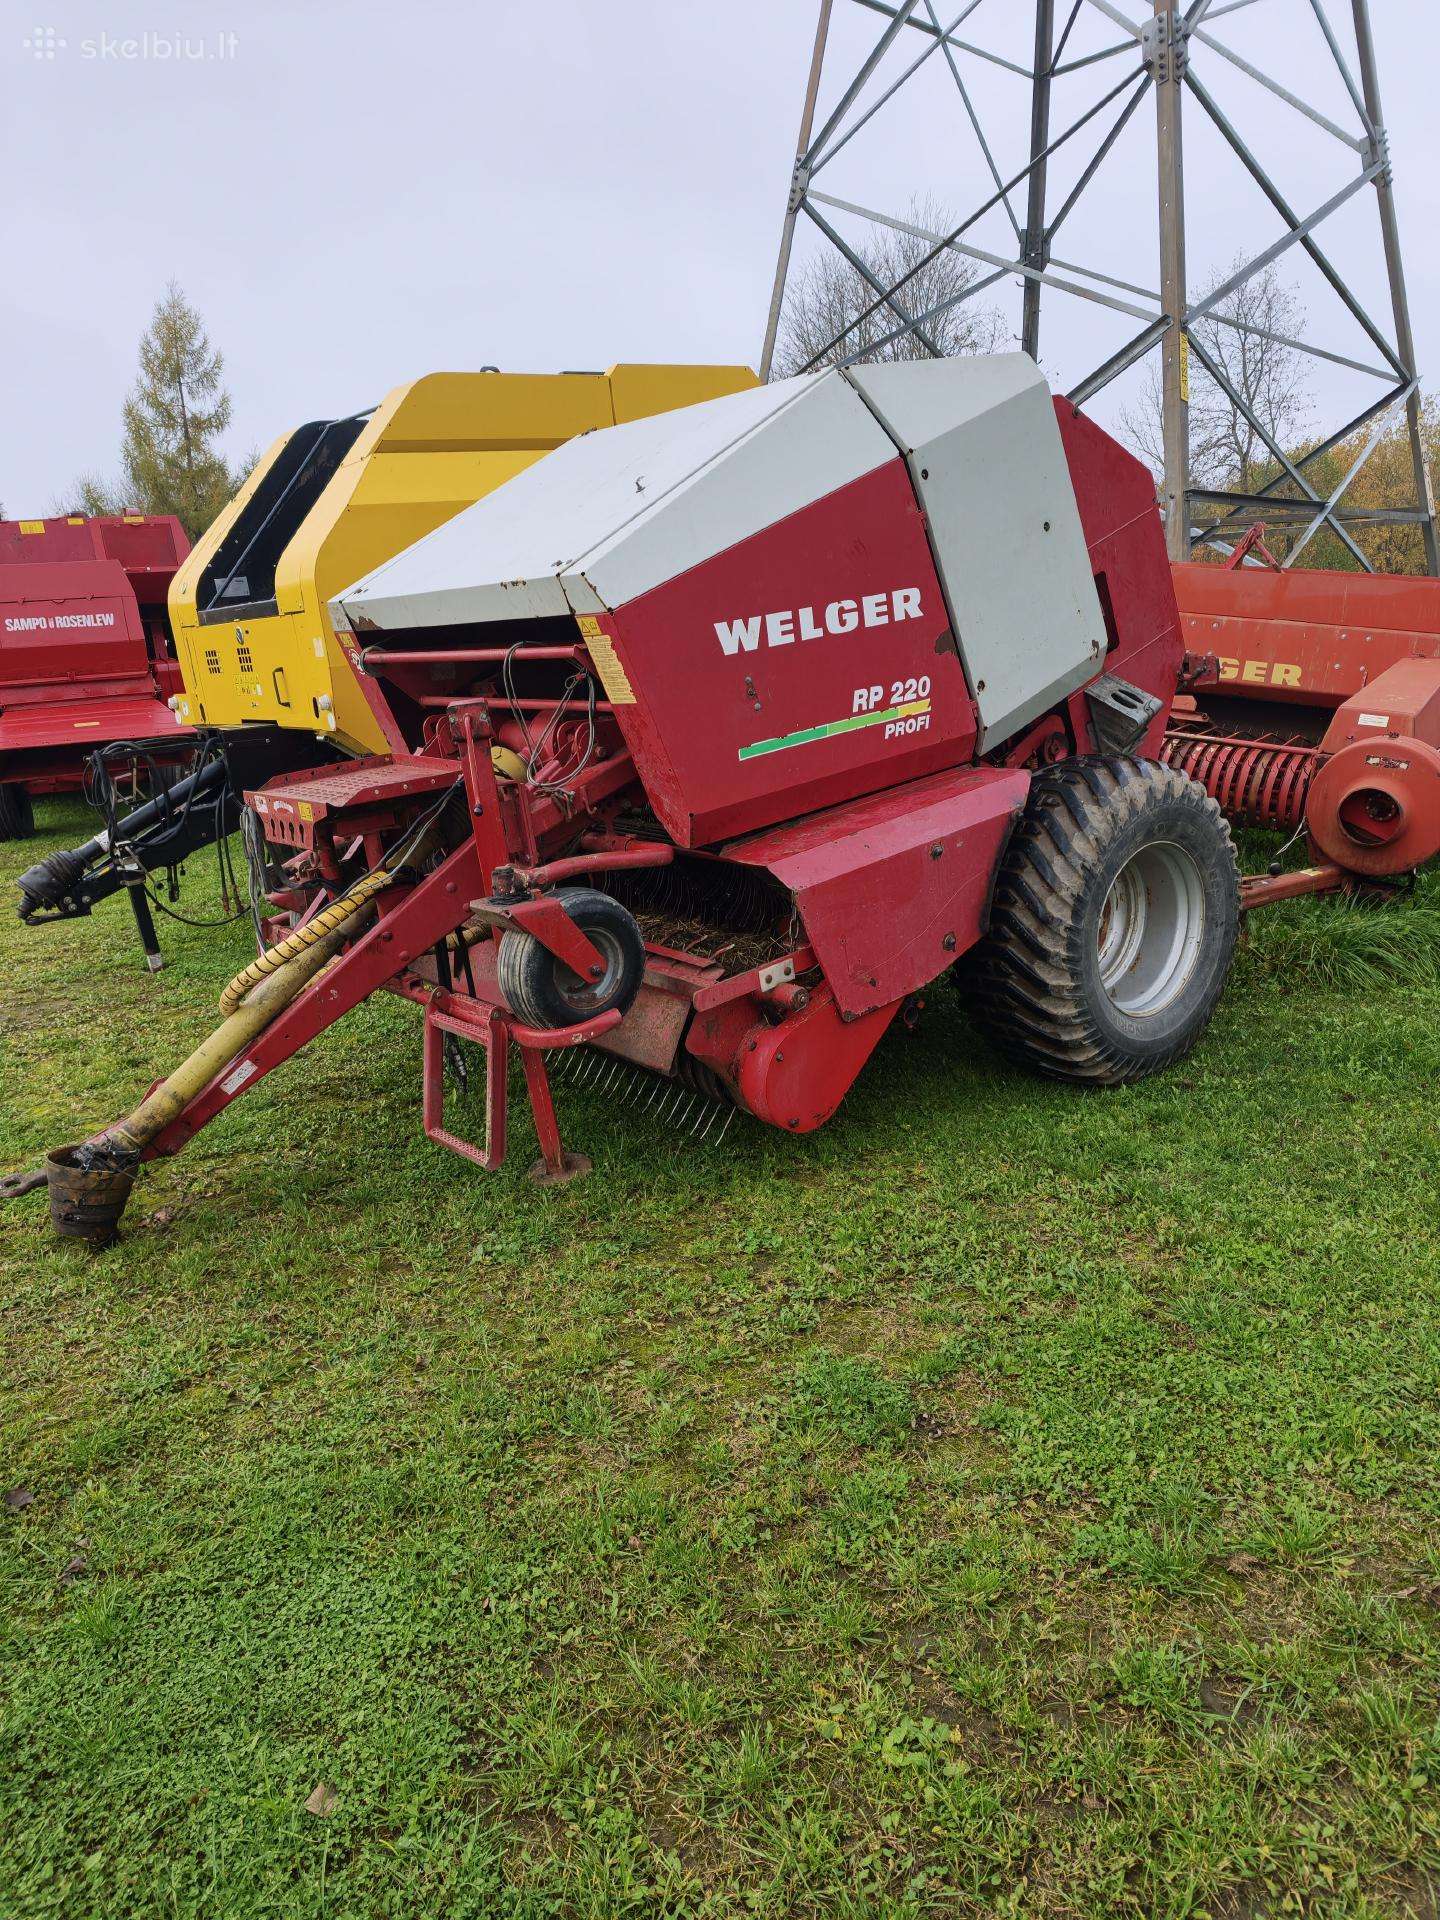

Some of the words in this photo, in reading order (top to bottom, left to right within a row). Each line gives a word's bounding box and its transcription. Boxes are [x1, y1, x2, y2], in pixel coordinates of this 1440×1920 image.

[5, 616, 47, 632] SAMPO
[55, 613, 114, 628] ROSENLEW
[713, 587, 924, 656] WELGER
[852, 685, 884, 713] RP
[889, 675, 931, 704] 220
[884, 714, 931, 740] PROFI
